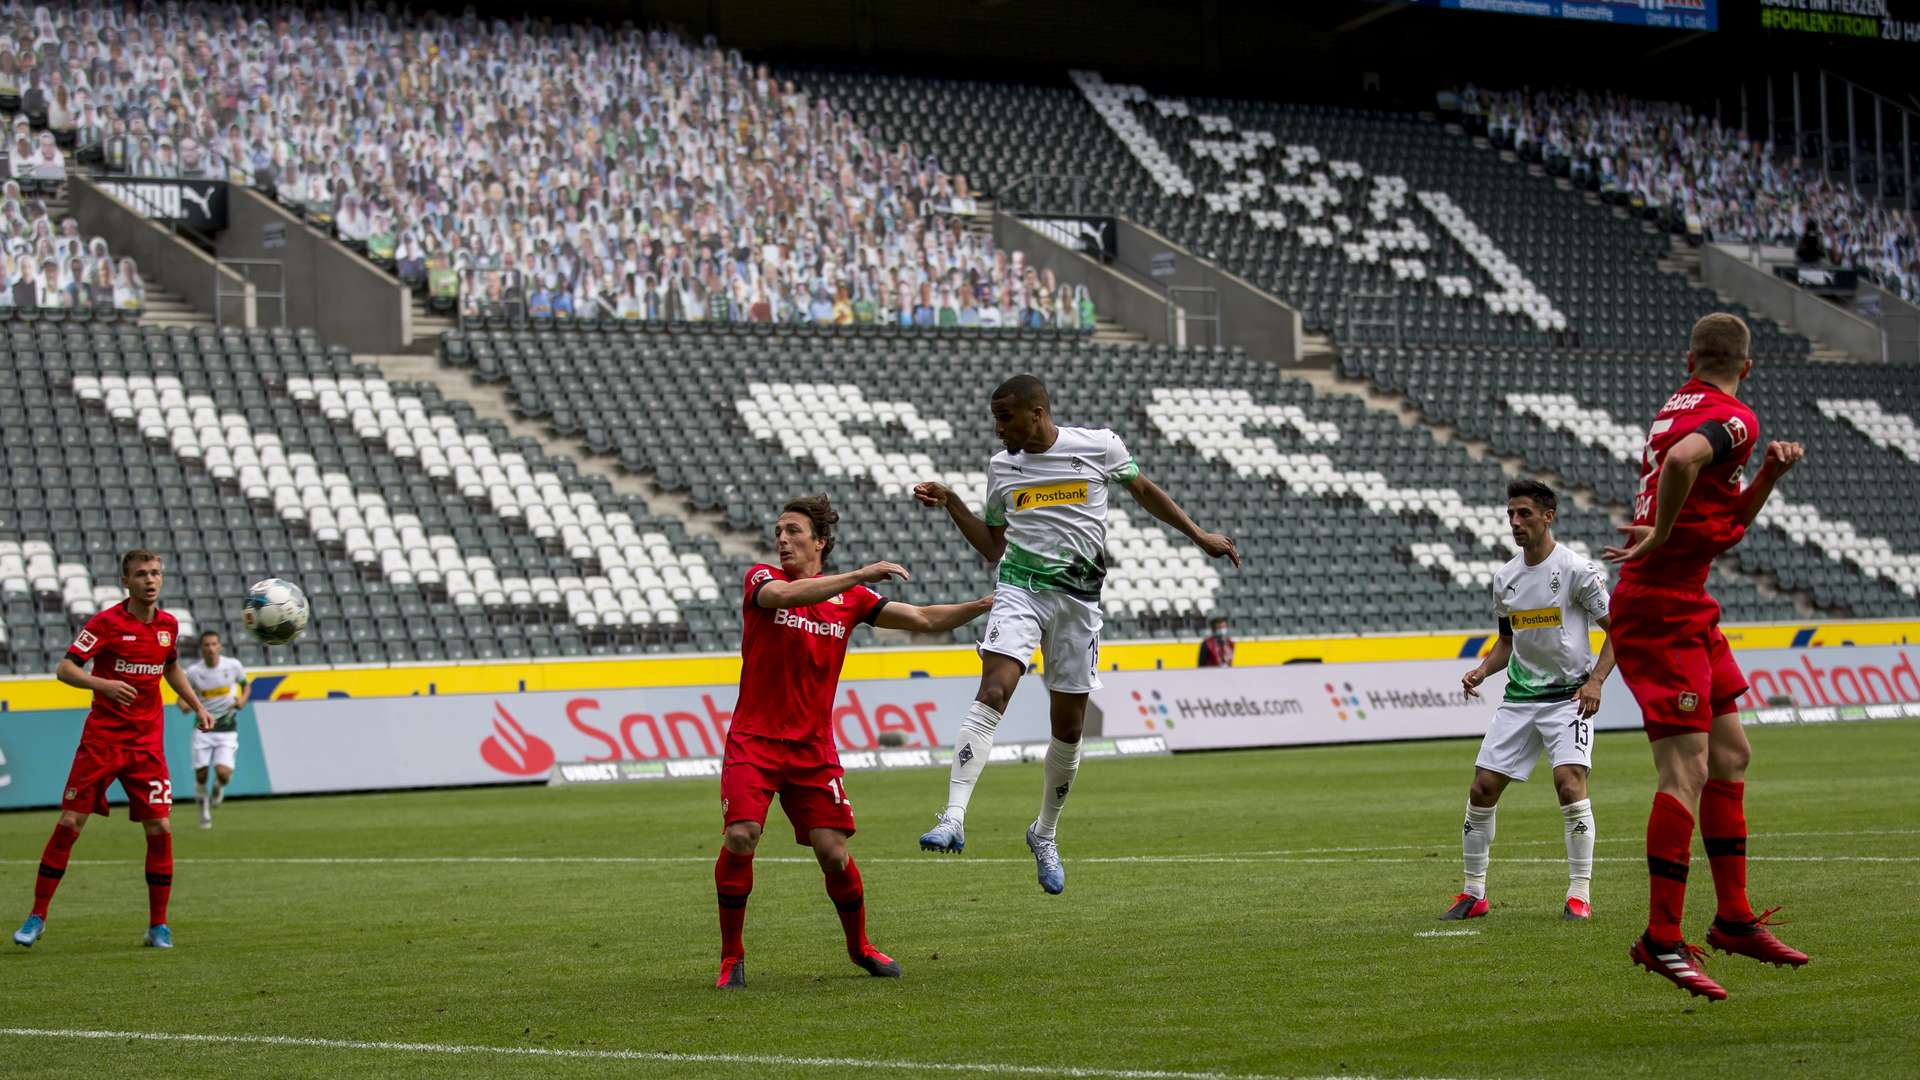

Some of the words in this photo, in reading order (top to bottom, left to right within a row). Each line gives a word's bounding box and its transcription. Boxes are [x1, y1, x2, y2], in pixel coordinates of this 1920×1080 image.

[1761, 8, 1878, 37] #FOHLENSTROM
[1881, 19, 1901, 40] ZU
[94, 182, 181, 219] UMA
[1661, 393, 1705, 412] ENDER
[1035, 489, 1087, 503] Postbank
[774, 608, 846, 639] Barmenia
[1522, 613, 1560, 625] Postbank
[114, 659, 164, 675] Barmen
[1742, 651, 1920, 709] antand
[1176, 697, 1304, 719] H-Hotels.com
[565, 689, 940, 762] Santder
[1568, 719, 1589, 746] 13
[149, 780, 172, 804] 22
